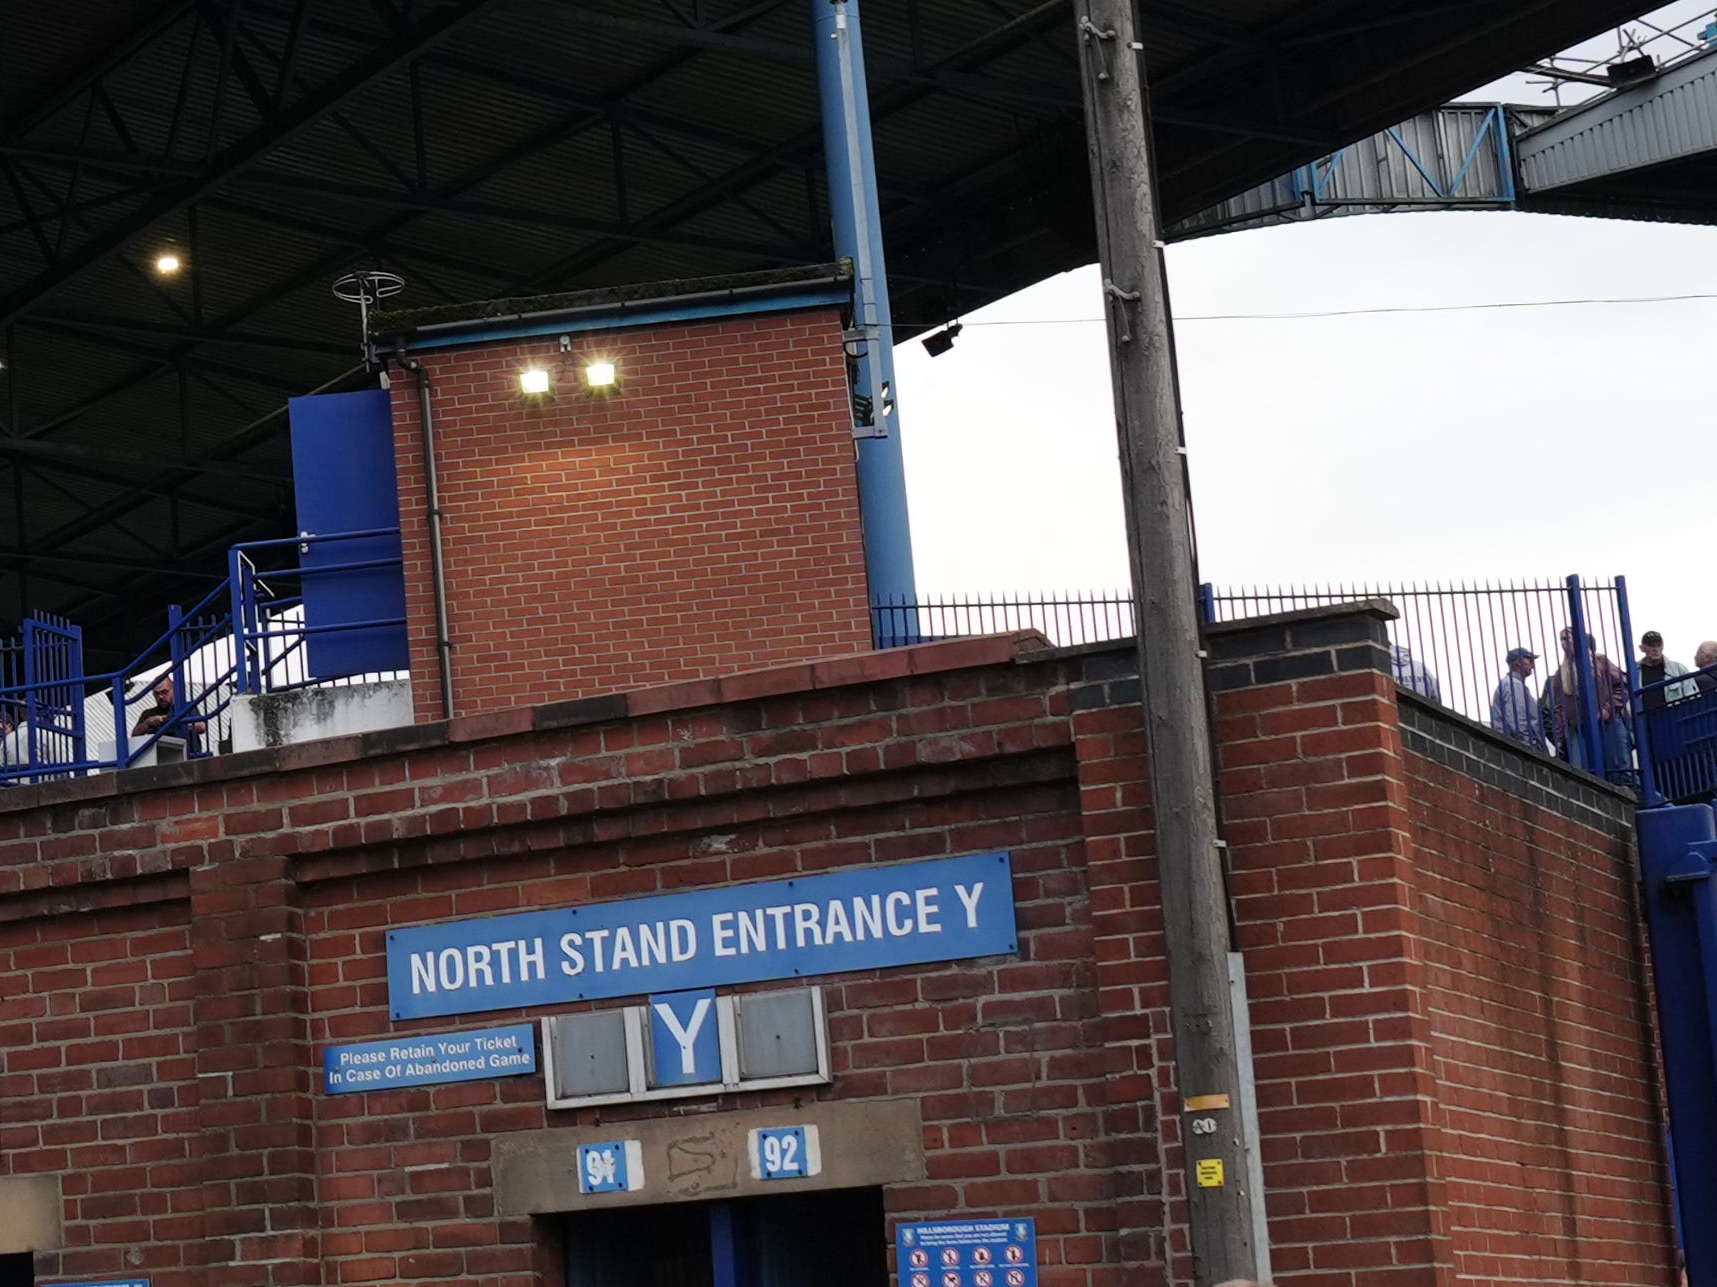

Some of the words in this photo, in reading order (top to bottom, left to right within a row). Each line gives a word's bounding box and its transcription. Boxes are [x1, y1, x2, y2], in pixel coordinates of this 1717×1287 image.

[409, 936, 546, 994] NORTH
[560, 918, 698, 976] STAND
[712, 887, 942, 958] ENTRANCE
[954, 882, 984, 929] Y
[340, 1051, 386, 1066] Please
[390, 1045, 434, 1060] Retain
[438, 1042, 470, 1055] Your
[475, 1035, 517, 1051] Ticket
[653, 998, 712, 1074] Y
[330, 1071, 342, 1084] In
[346, 1068, 381, 1083] Case
[385, 1065, 401, 1078] Of
[405, 1057, 485, 1076] Abandoned
[489, 1052, 530, 1068] Game
[764, 1135, 799, 1172] 92
